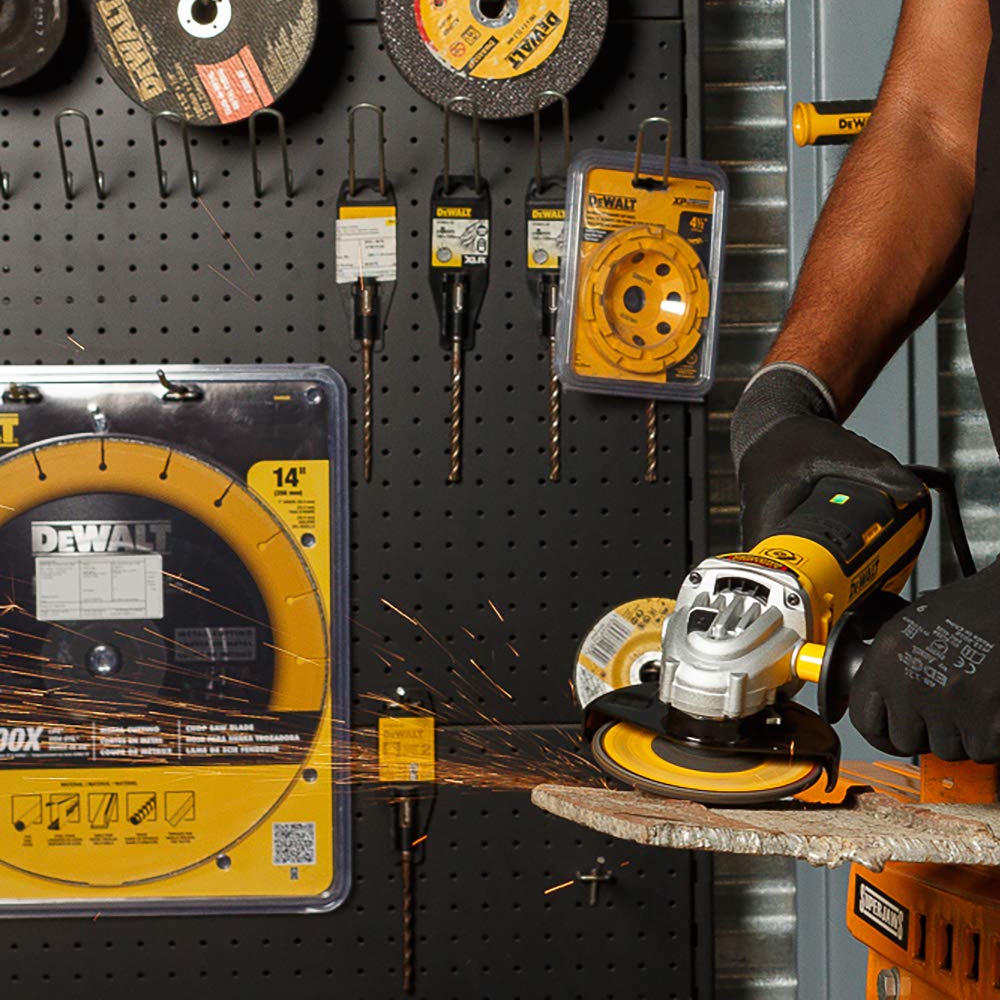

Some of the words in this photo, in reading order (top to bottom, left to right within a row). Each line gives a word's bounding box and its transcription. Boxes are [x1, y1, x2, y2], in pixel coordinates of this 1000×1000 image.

[504, 9, 562, 71] DEWALT
[838, 118, 866, 129] DEW
[588, 194, 637, 211] DEWALT
[436, 207, 472, 217] DEWALT
[31, 521, 171, 553] DEWALT
